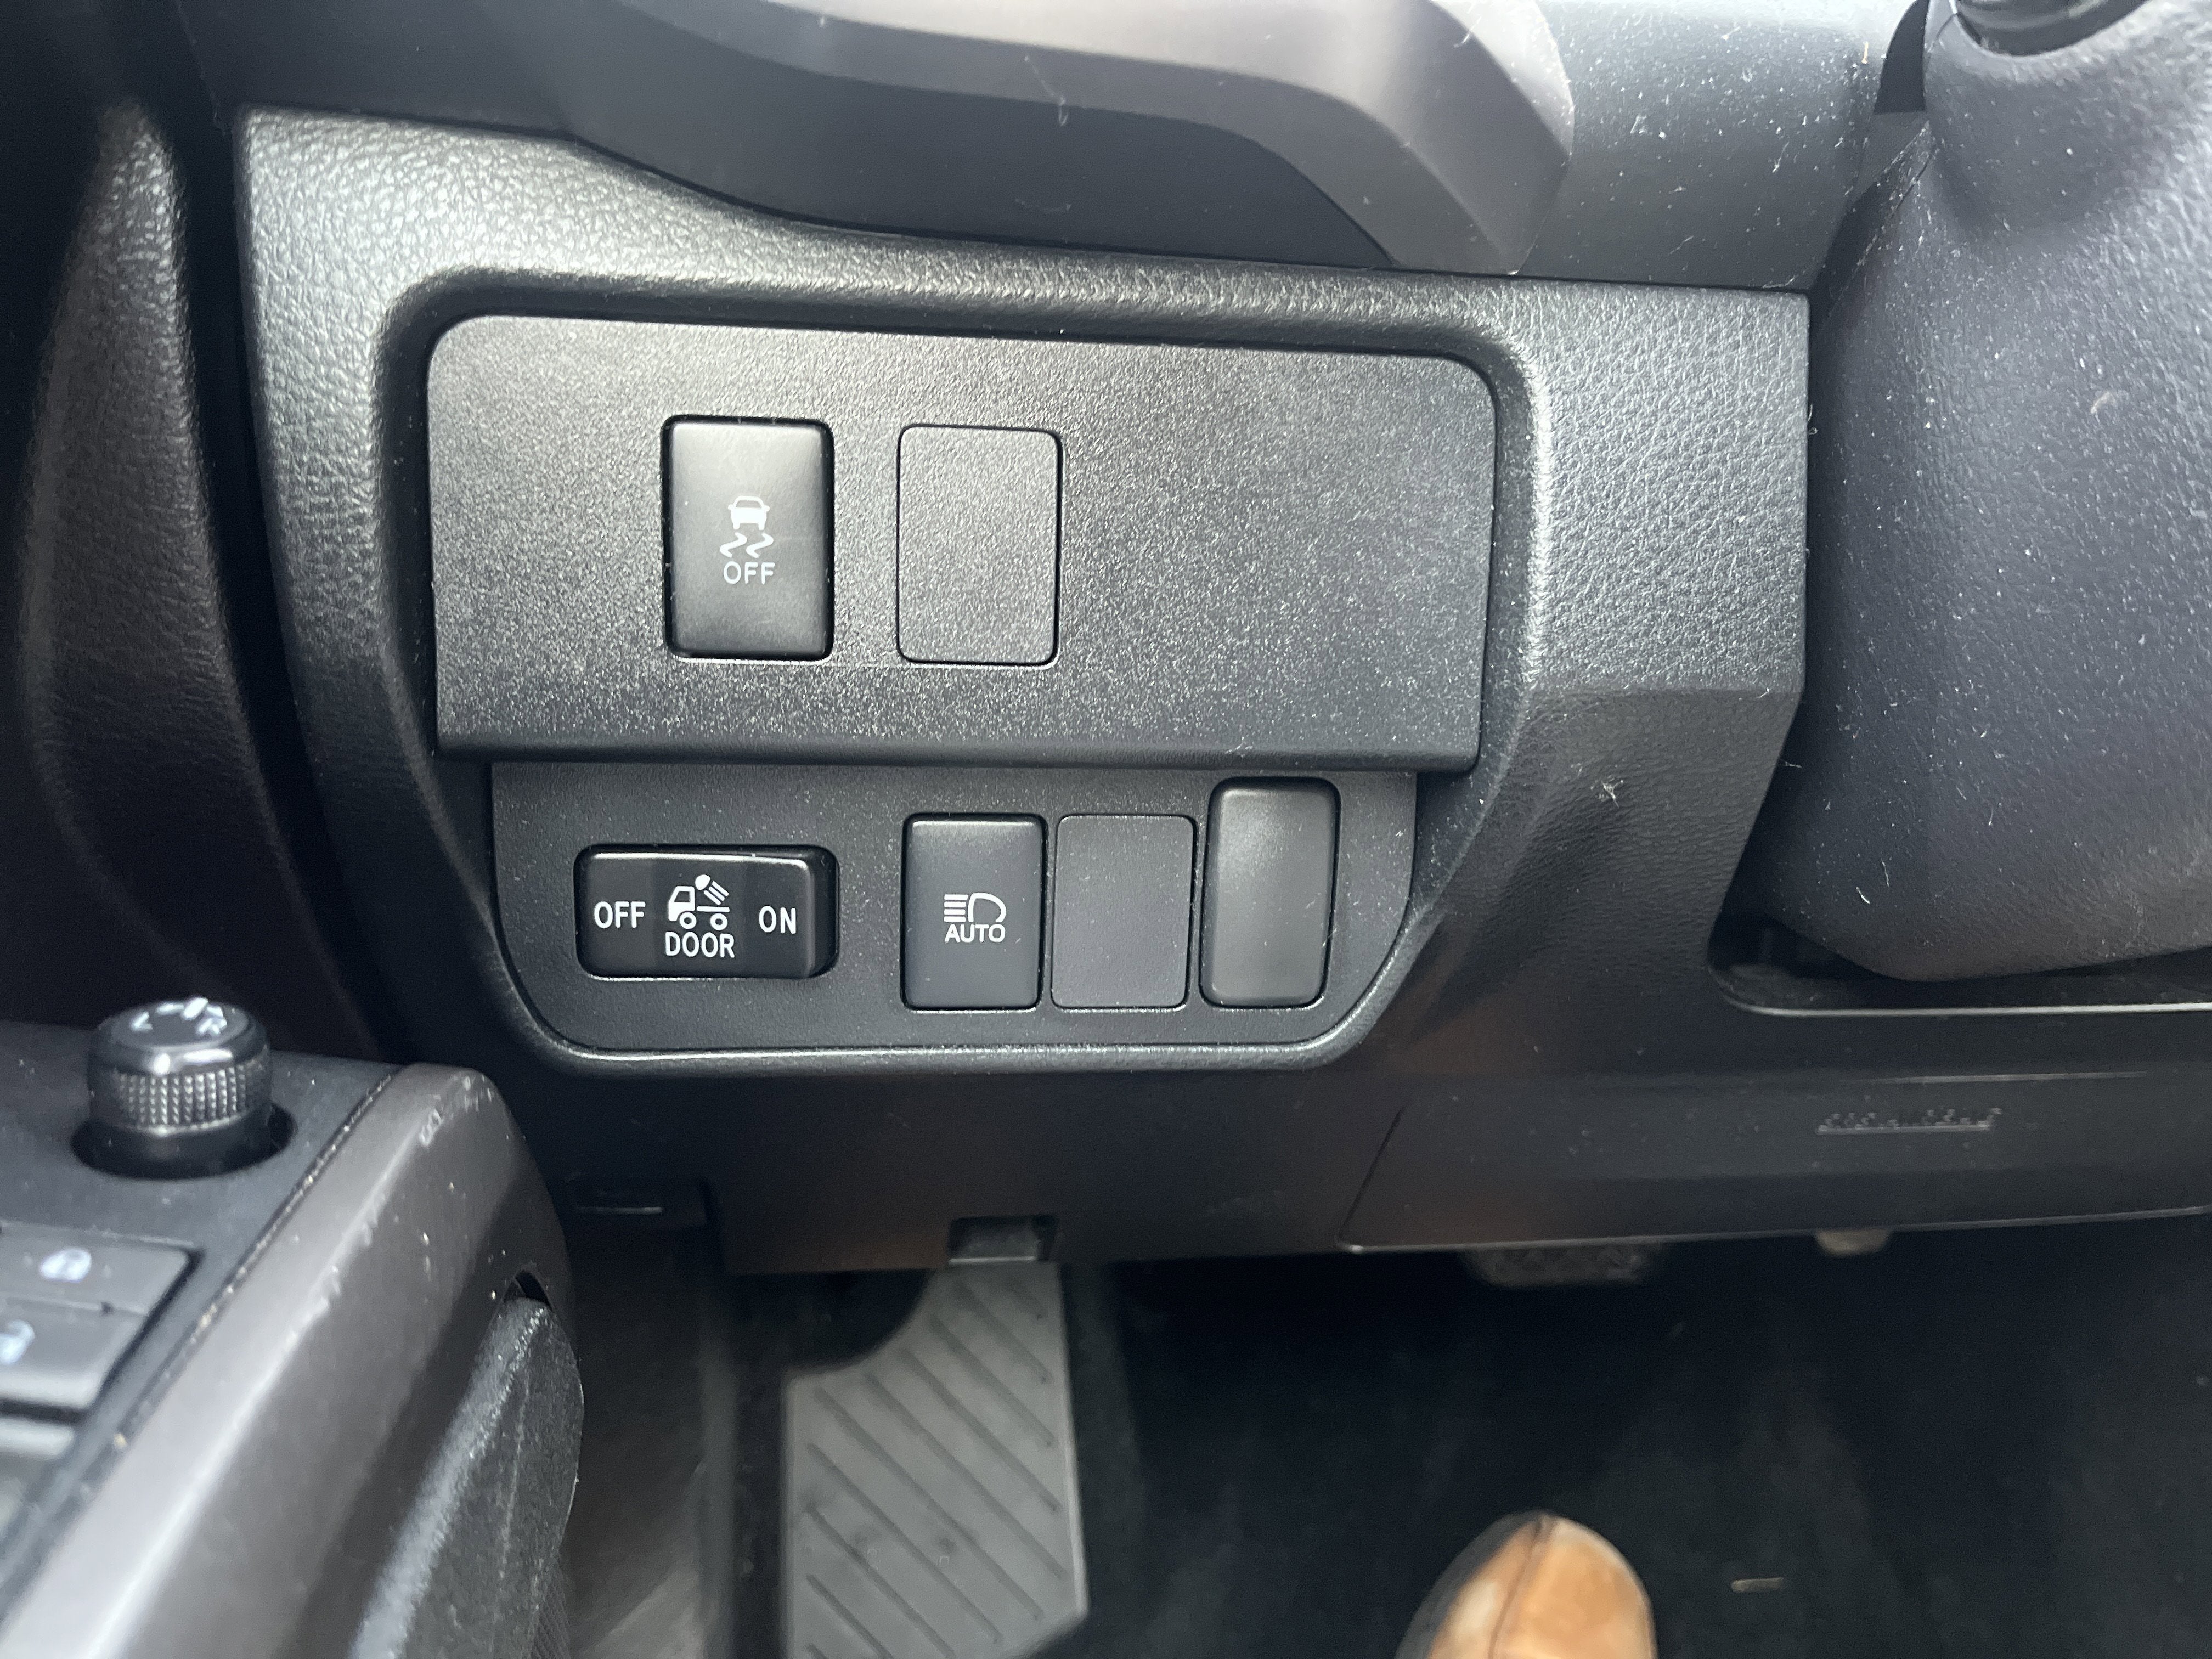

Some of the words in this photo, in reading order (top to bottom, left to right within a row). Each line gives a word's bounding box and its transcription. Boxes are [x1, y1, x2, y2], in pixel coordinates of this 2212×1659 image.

[724, 561, 775, 584] OFF
[594, 901, 646, 929] OFF
[758, 906, 796, 934] ON
[665, 931, 735, 958] DOOR
[944, 923, 1006, 943] AUTO
